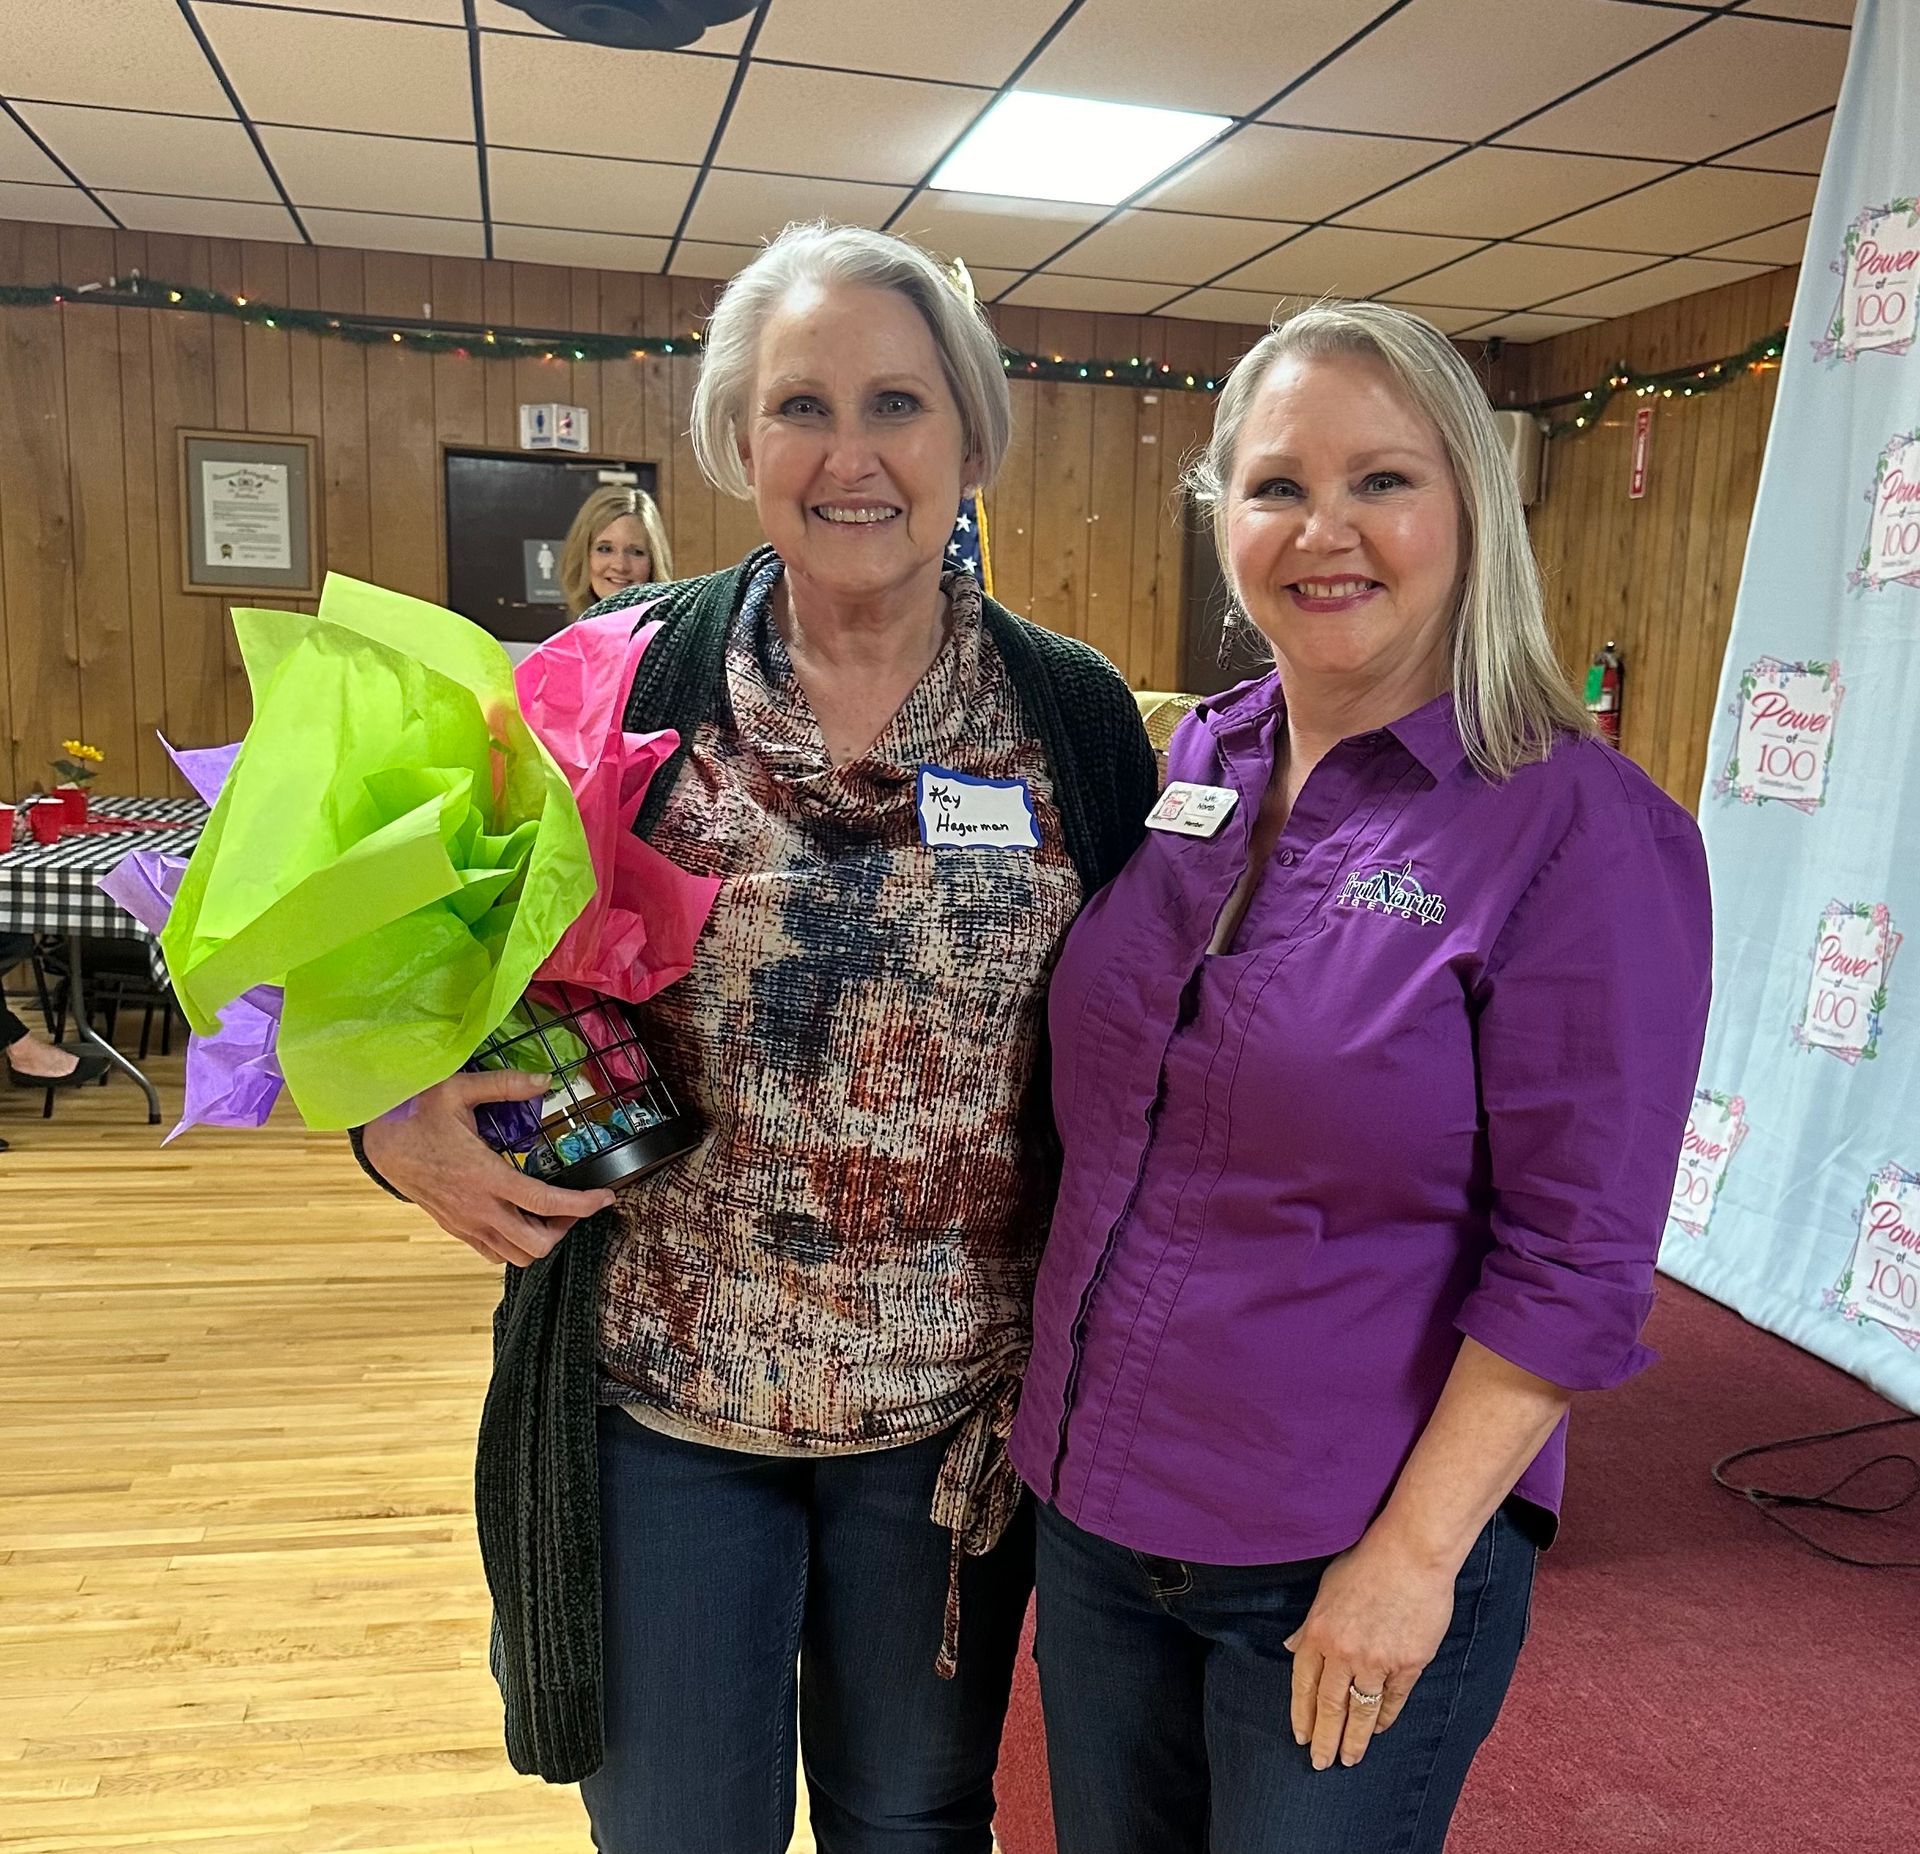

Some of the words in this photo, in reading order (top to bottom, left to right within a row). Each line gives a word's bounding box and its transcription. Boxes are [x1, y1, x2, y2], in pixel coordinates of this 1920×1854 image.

[1855, 292, 1906, 327] 100
[1881, 522, 1920, 557] 100
[1750, 692, 1831, 733] Power
[1785, 733, 1799, 745] of
[1756, 744, 1816, 781] 100
[928, 785, 961, 811] Kay
[1816, 935, 1878, 977] Power
[1812, 988, 1857, 1029] 100
[1688, 1158, 1700, 1168] of
[1675, 1167, 1708, 1206] 00
[1896, 1252, 1906, 1264] of
[1866, 1259, 1917, 1309] 100
